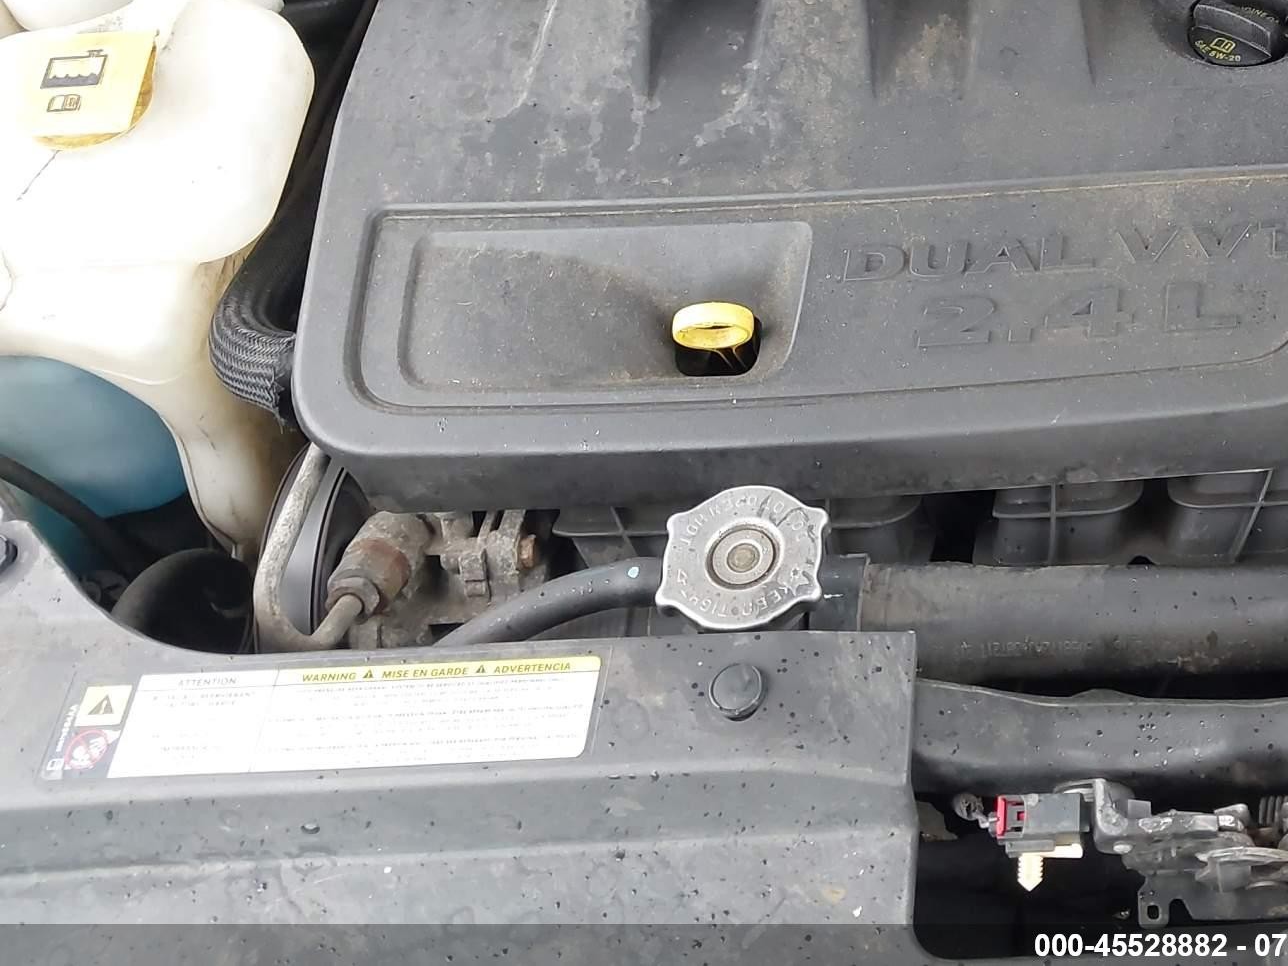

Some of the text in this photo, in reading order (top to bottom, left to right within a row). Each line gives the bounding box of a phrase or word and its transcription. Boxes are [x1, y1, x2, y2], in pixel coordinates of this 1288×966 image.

[1194, 40, 1212, 54] SAE
[843, 231, 1096, 282] DUAL
[302, 662, 571, 683] WARNING MISE EN GARDE ADVERTENCIA
[178, 676, 237, 687] ATTENTION
